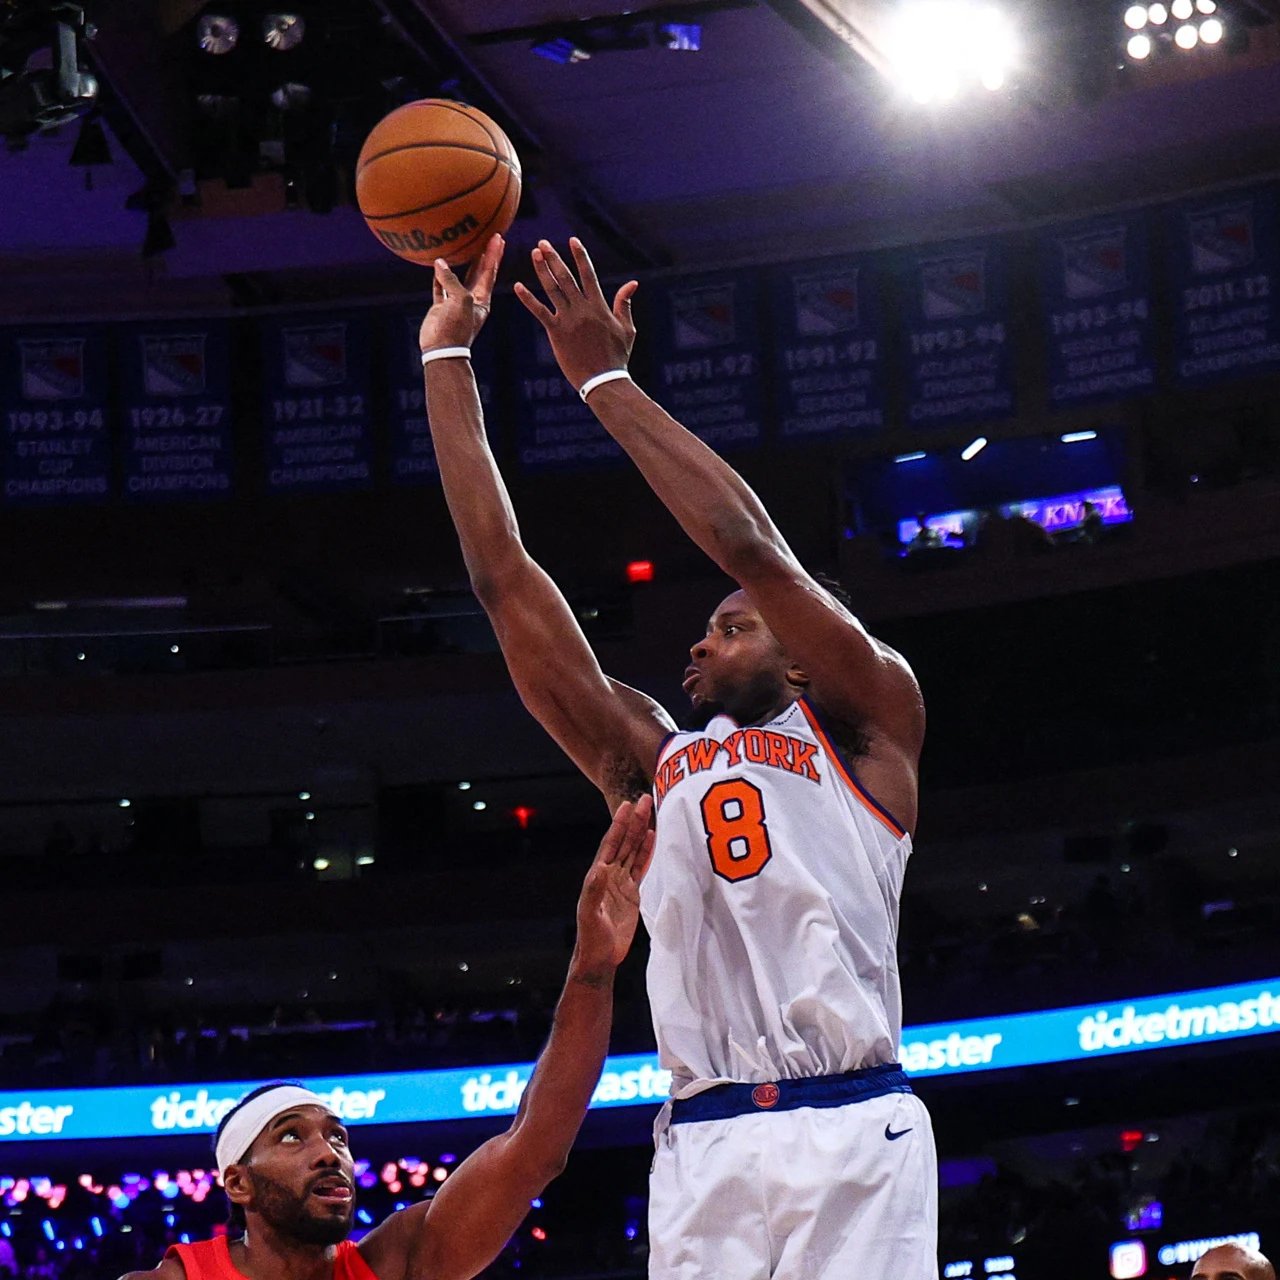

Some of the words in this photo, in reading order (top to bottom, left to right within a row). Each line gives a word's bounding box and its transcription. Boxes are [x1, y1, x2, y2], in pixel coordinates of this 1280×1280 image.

[375, 214, 480, 252] Wilson
[130, 406, 223, 429] 1926-27
[273, 396, 364, 419] 1931-32
[8, 409, 103, 432] 1993-94
[39, 459, 74, 475] CUP
[128, 474, 229, 492] CHAMPIONS
[655, 738, 719, 803] NEW
[721, 729, 821, 786] YORK
[700, 777, 772, 883] 8
